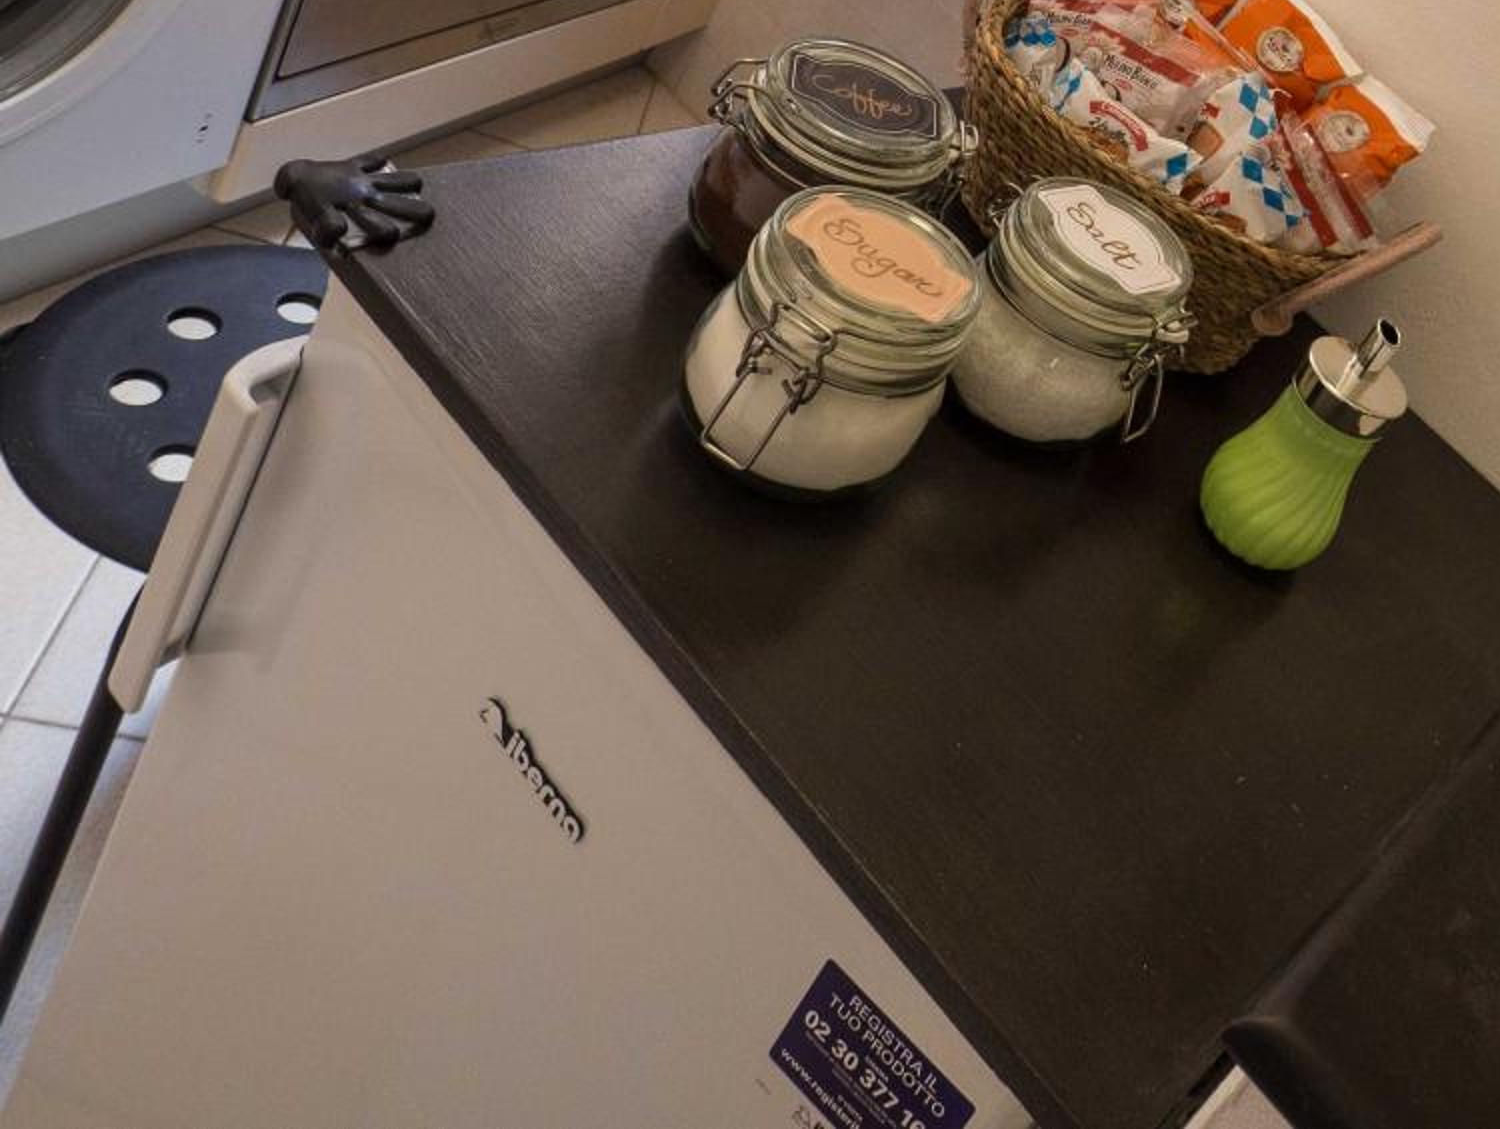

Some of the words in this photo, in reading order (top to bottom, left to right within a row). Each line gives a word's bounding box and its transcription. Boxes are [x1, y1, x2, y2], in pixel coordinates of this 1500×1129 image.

[811, 74, 913, 120] Coffee
[822, 216, 945, 299] Sugar
[1065, 201, 1141, 272] Salt
[805, 1009, 832, 1044] 02
[831, 1038, 859, 1071] 30
[860, 1068, 899, 1109] 377
[829, 991, 862, 1032] TUO
[861, 1030, 946, 1118] PRODOTTO
[848, 994, 923, 1078] REGISTRA
[924, 1072, 938, 1094] IL
